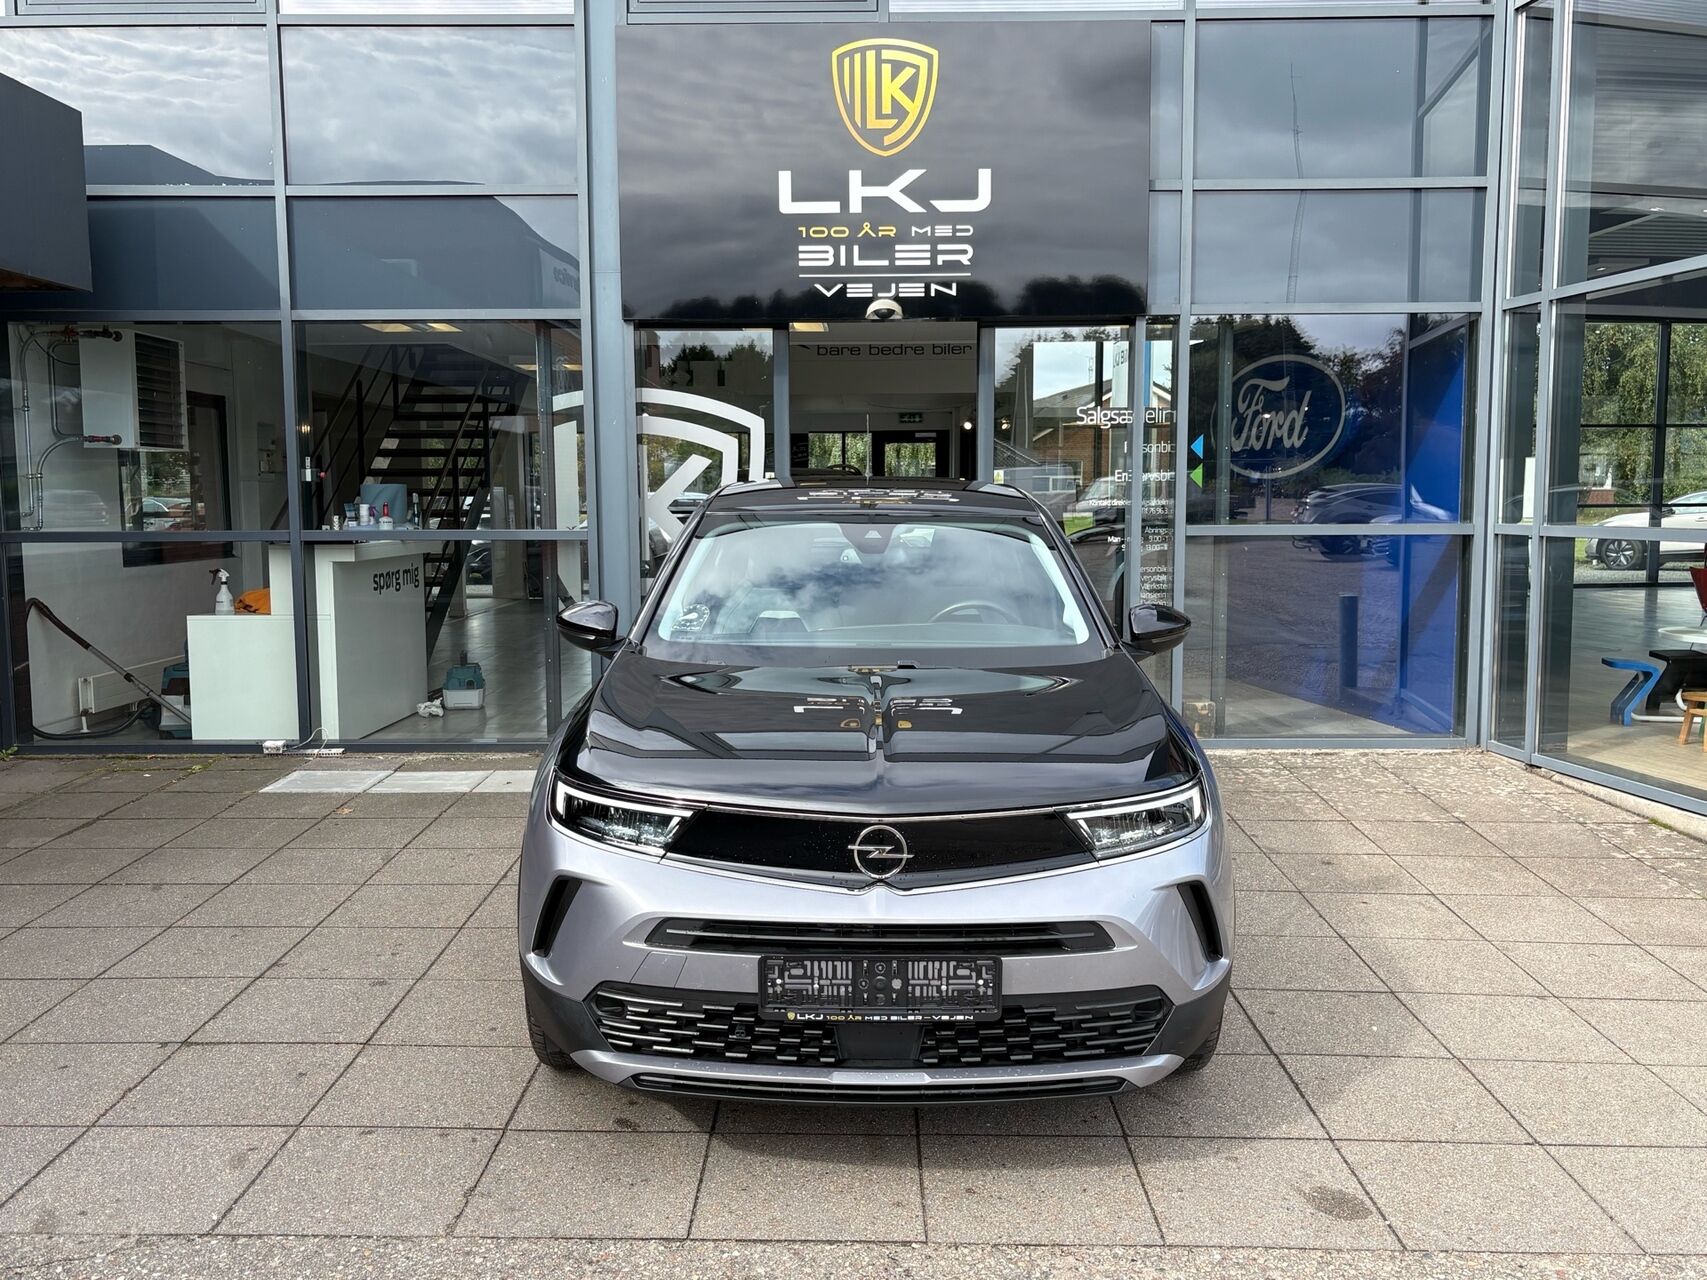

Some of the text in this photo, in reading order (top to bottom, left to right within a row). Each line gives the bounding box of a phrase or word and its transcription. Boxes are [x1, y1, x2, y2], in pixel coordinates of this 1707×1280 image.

[778, 168, 992, 214] LKJ
[798, 221, 974, 238] 100 ÅR MED
[798, 243, 974, 267] BILER
[814, 282, 957, 298] VEJEN
[816, 343, 973, 357] bare bedre biler
[1231, 376, 1312, 453] Ford
[373, 562, 420, 595] spørg mig
